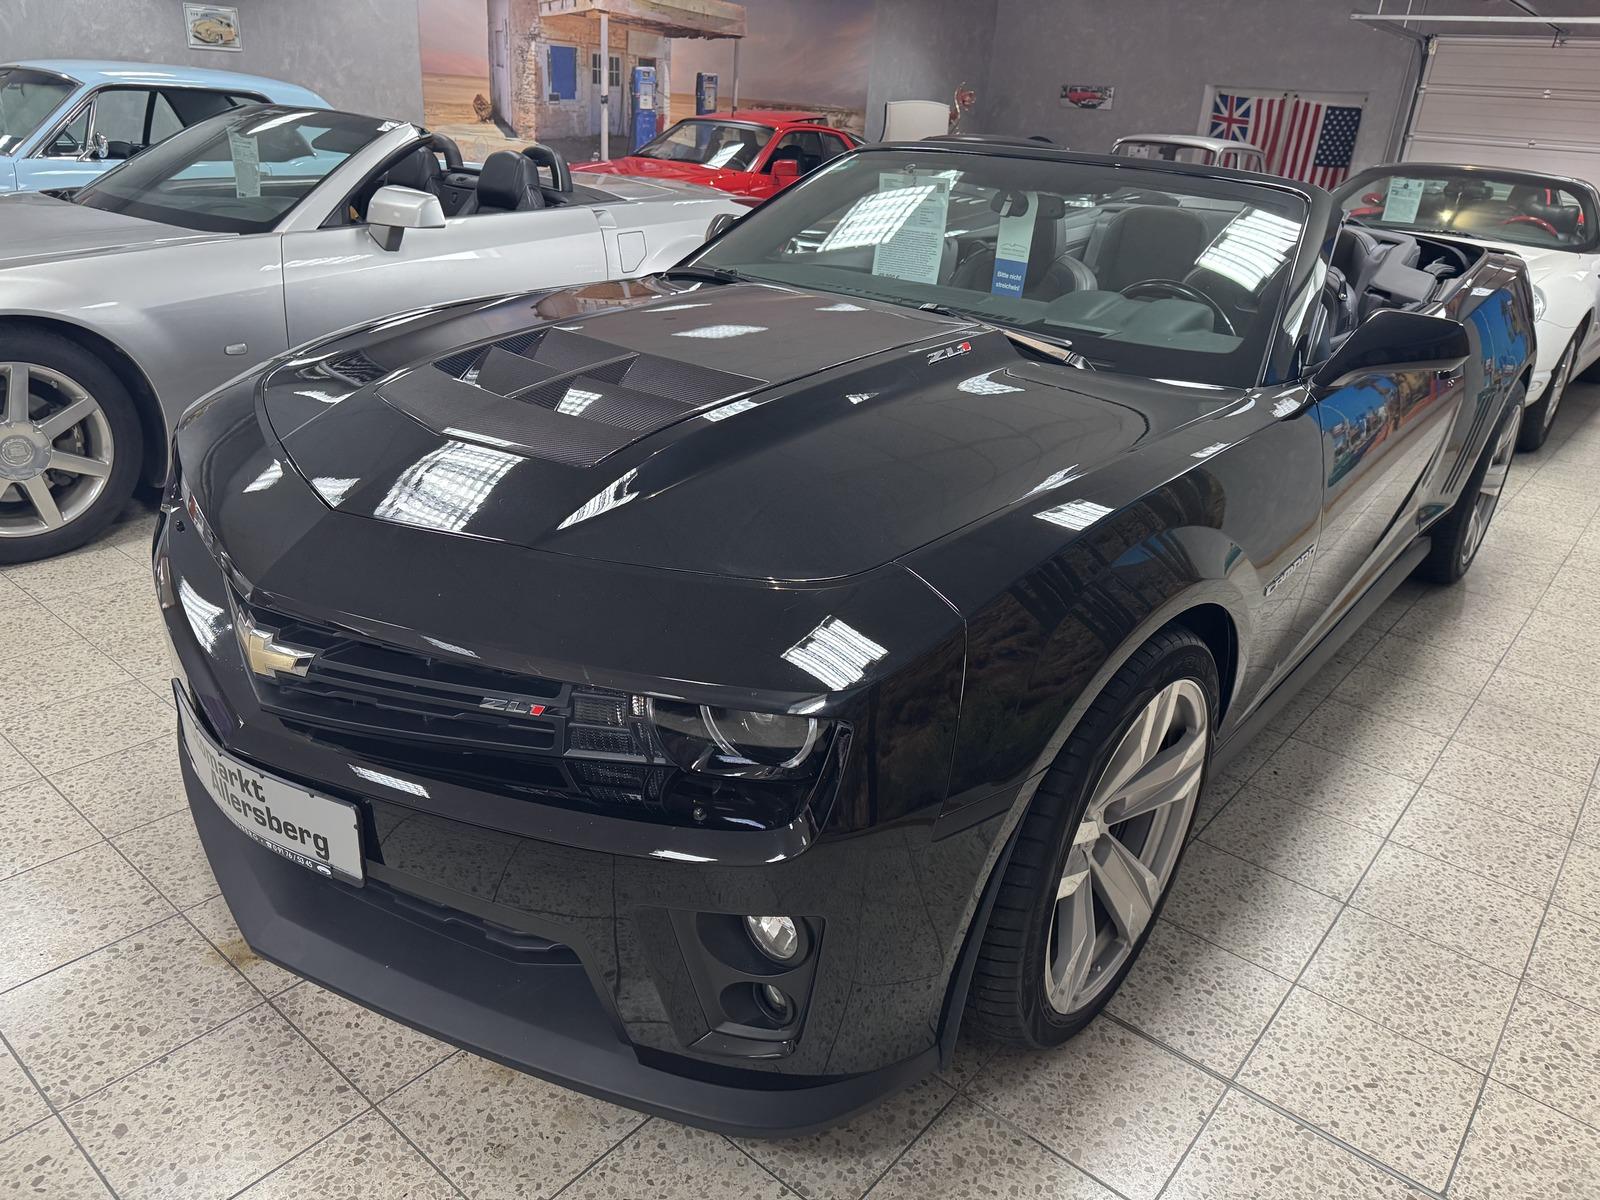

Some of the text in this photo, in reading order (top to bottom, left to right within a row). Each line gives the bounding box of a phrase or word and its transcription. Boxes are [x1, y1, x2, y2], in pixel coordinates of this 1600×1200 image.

[1009, 274, 1022, 282] nicht
[926, 341, 972, 364] ZL1
[479, 697, 546, 717] ZL1
[211, 770, 330, 861] Allersberg
